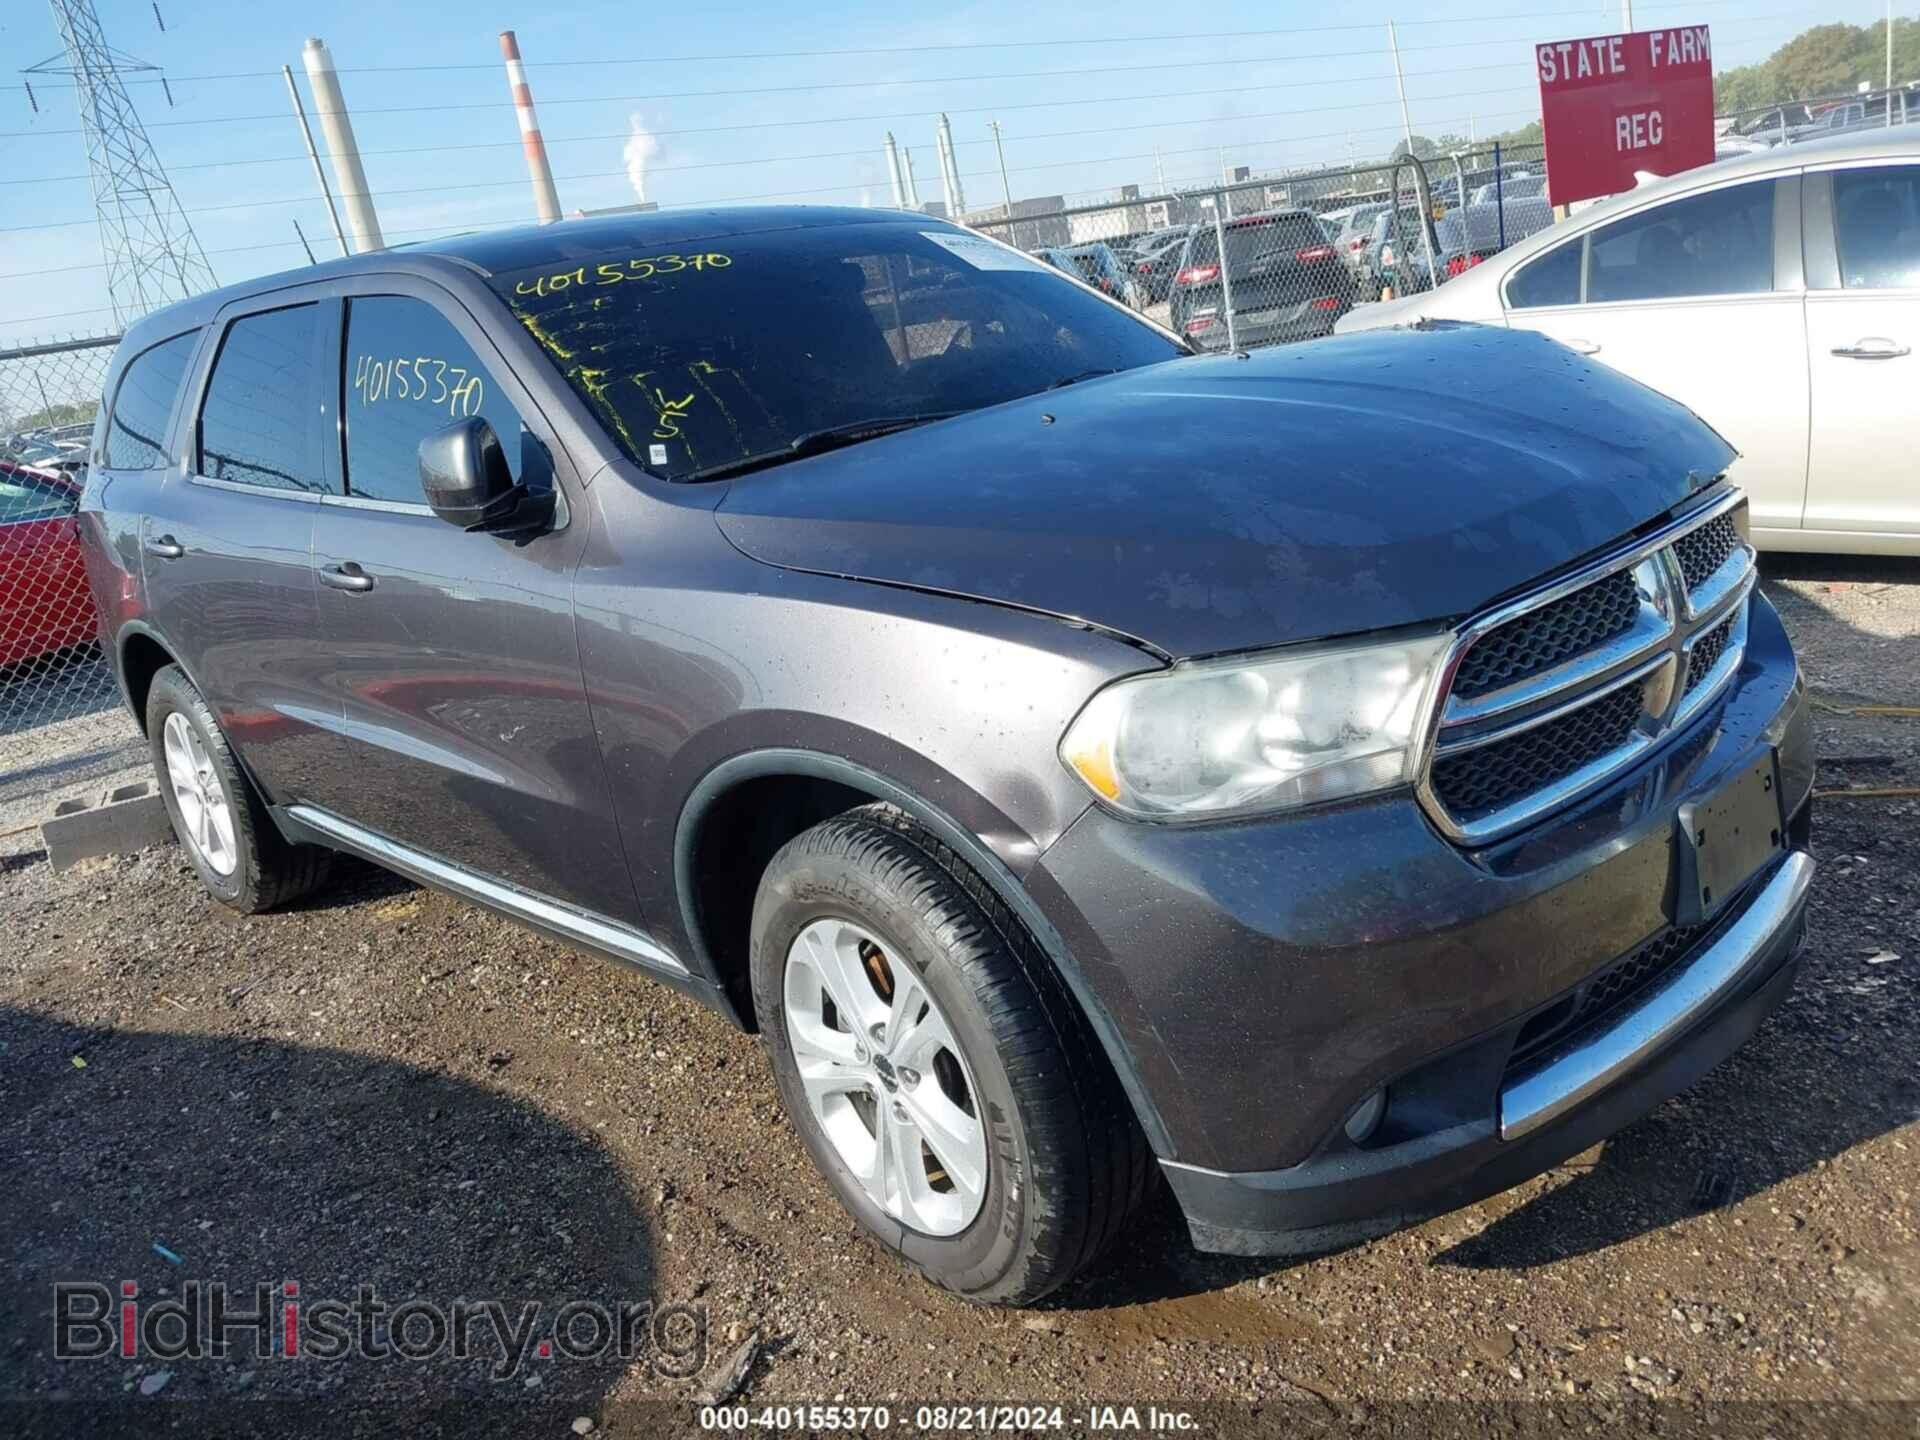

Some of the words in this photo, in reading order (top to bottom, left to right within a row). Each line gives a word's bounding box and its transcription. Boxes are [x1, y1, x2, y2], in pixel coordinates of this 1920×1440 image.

[1539, 37, 1626, 83] STATE
[1650, 27, 1712, 68] FARM
[1615, 110, 1663, 152] REG
[515, 253, 732, 297] 40155370
[354, 354, 484, 417] 40155370
